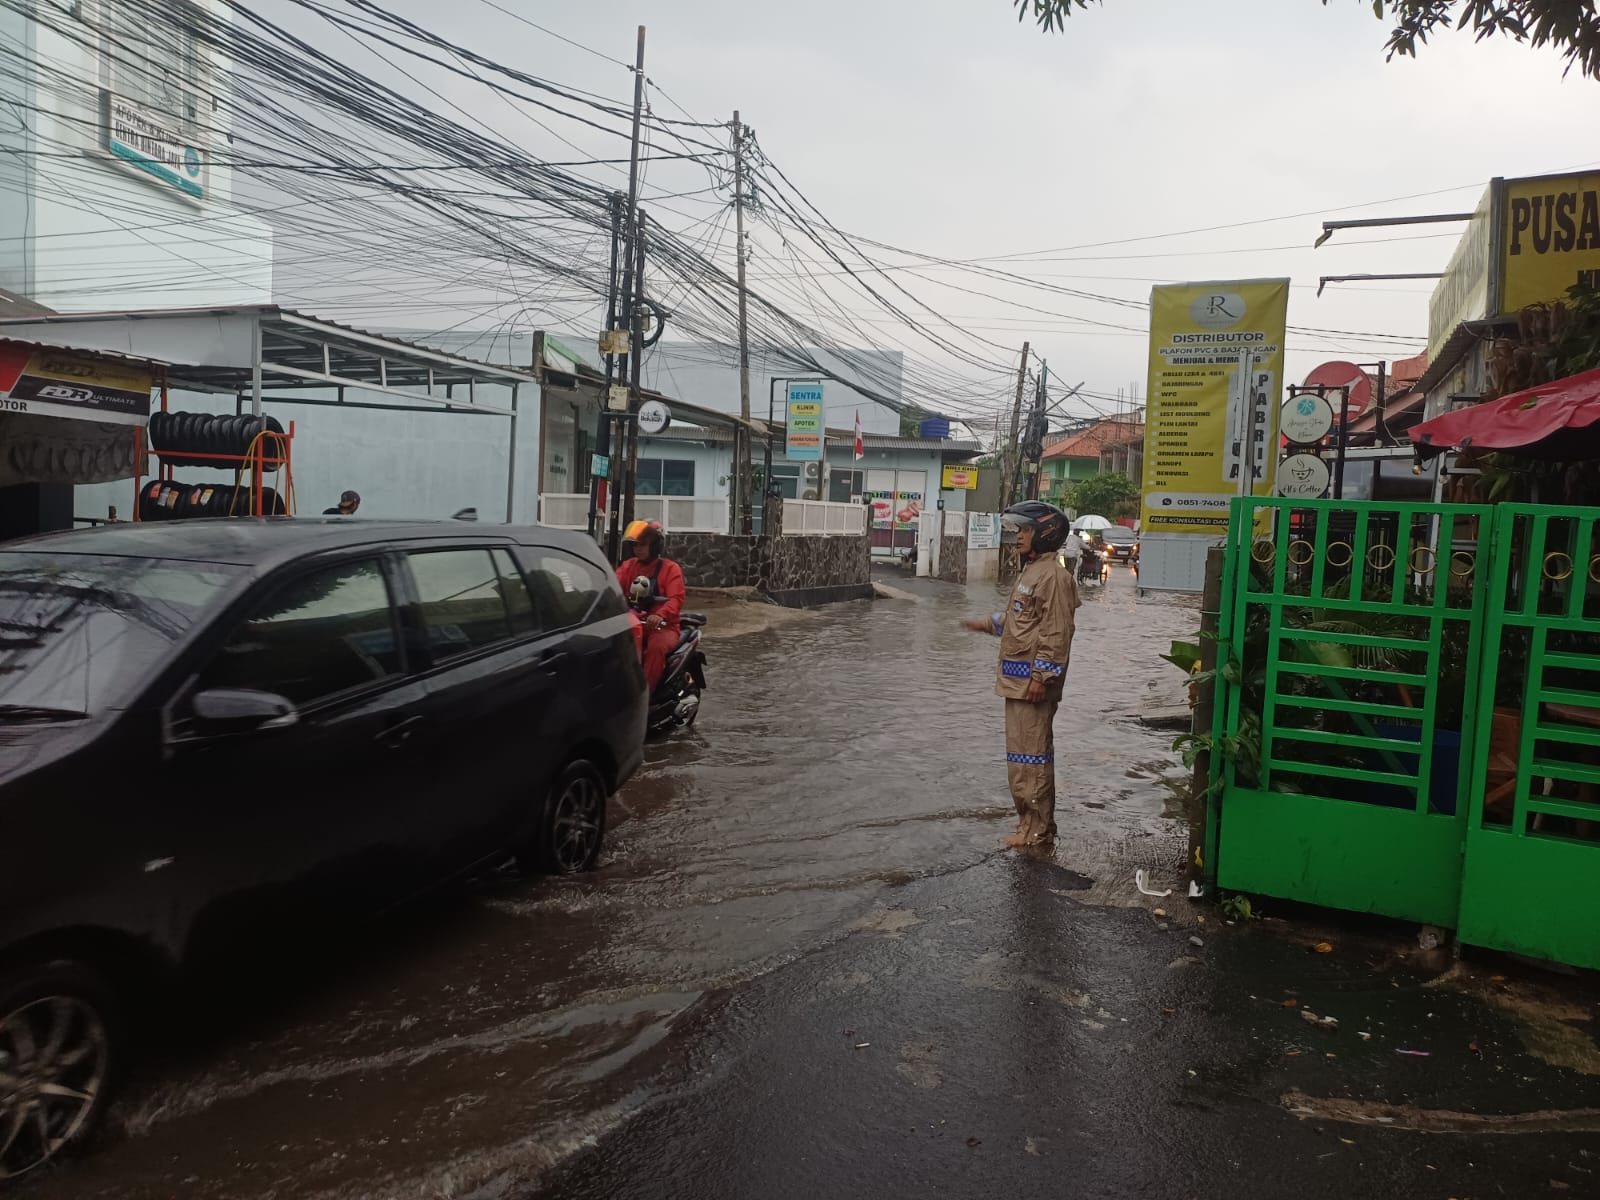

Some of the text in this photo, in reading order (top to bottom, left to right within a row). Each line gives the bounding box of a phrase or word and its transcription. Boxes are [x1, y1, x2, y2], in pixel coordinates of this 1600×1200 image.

[1173, 332, 1264, 343] DISTRIBUTOR
[36, 385, 136, 405] FDR ULTIMATE
[790, 391, 821, 400] SENTRA
[0, 400, 28, 411] TOR
[1251, 374, 1269, 479] PABRIK
[1298, 484, 1321, 493] Coffee
